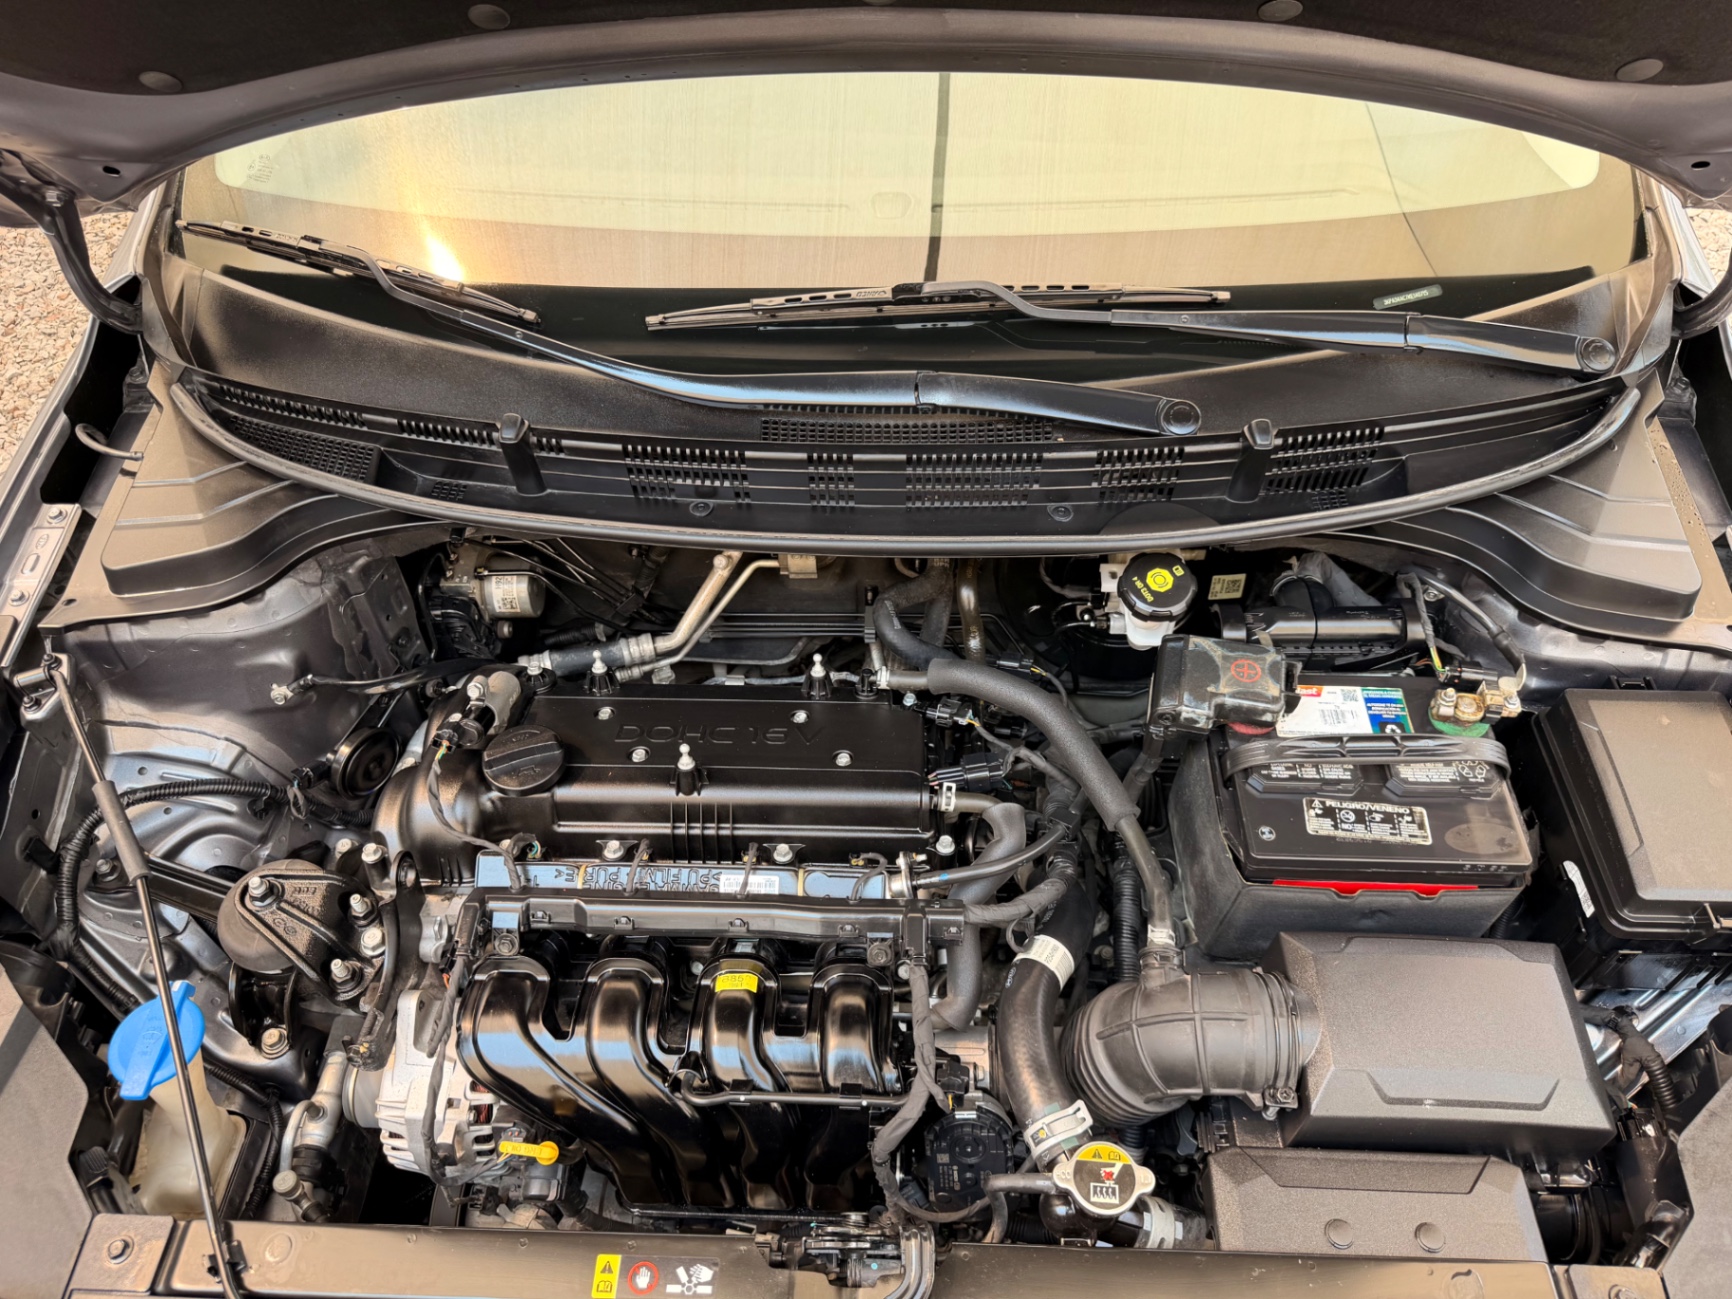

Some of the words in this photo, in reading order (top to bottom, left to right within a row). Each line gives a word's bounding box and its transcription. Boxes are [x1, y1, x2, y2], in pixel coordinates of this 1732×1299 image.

[1135, 580, 1144, 589] OR
[614, 724, 736, 744] DOHC
[748, 726, 822, 746] 16V
[1325, 800, 1410, 814] PELIGRO/VENENO
